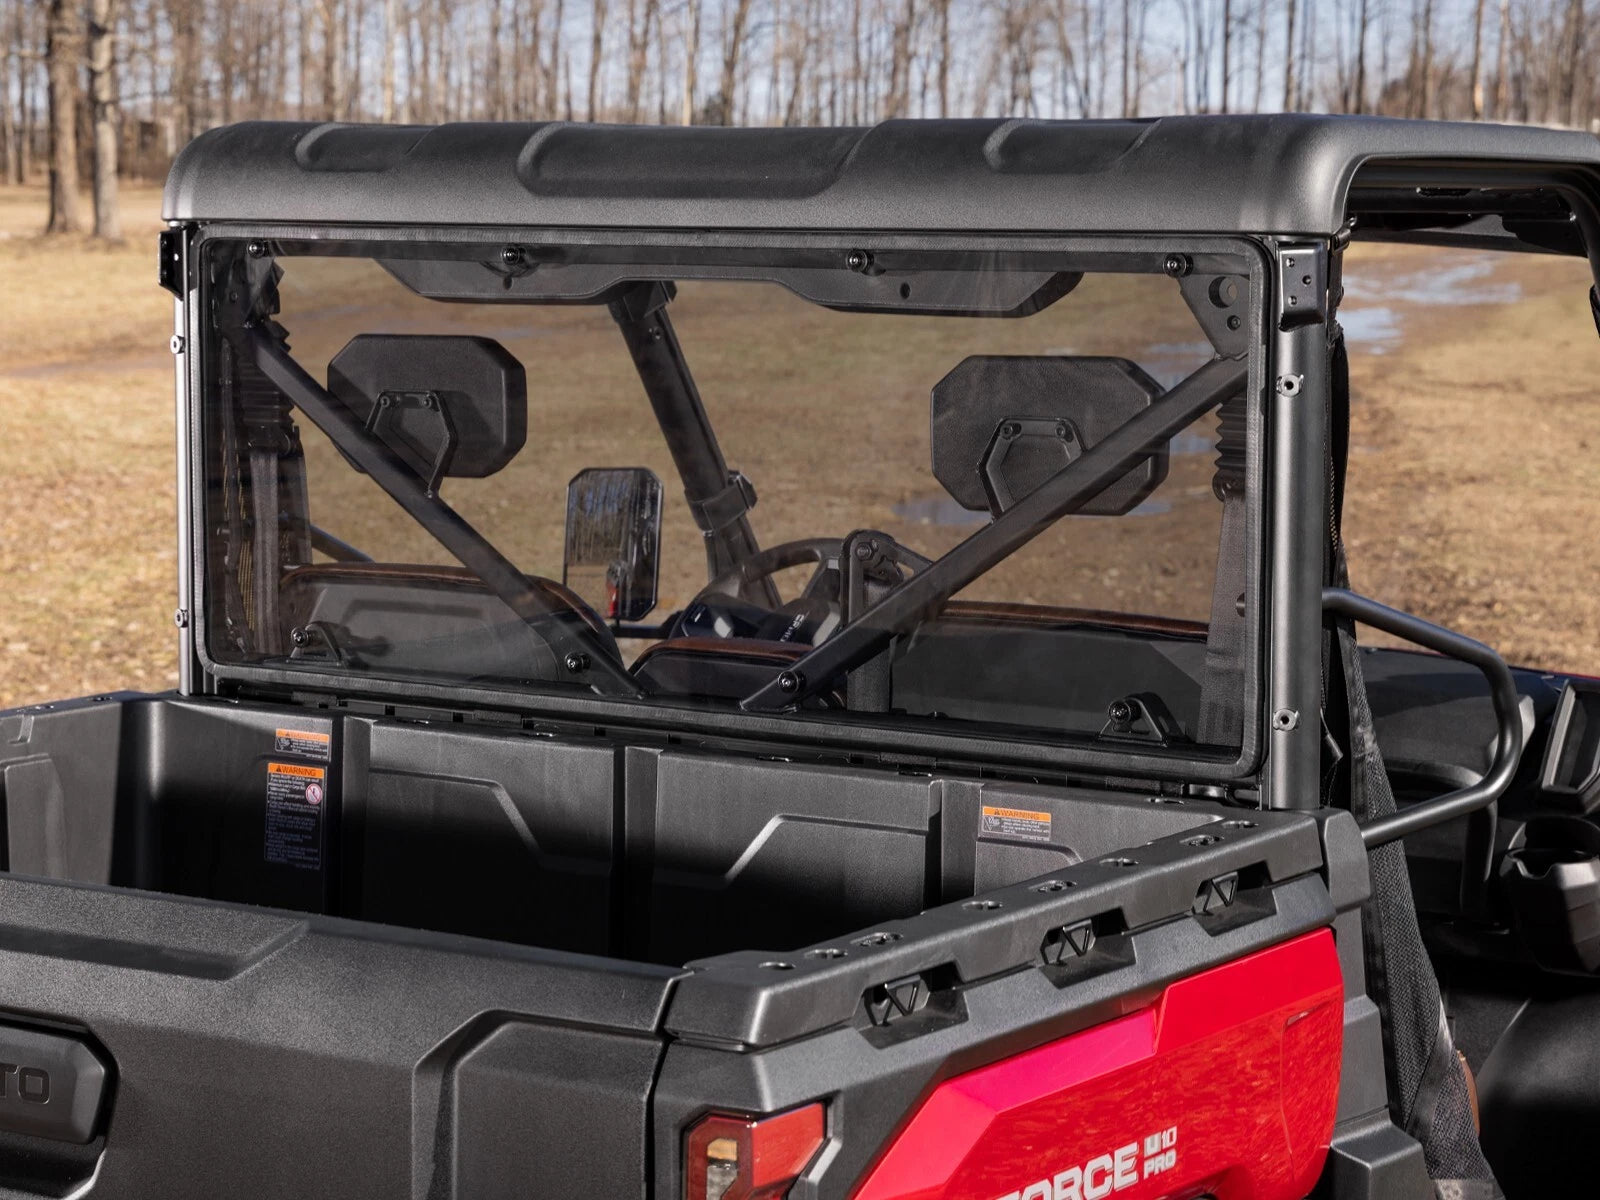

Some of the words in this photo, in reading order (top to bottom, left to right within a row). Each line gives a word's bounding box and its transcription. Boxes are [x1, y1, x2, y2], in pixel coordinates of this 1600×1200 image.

[281, 765, 317, 777] WARNING
[1000, 809, 1040, 820] WARNING
[996, 1142, 1138, 1200] ORCE
[1144, 1126, 1177, 1158] U10
[1143, 1150, 1177, 1180] PRO
